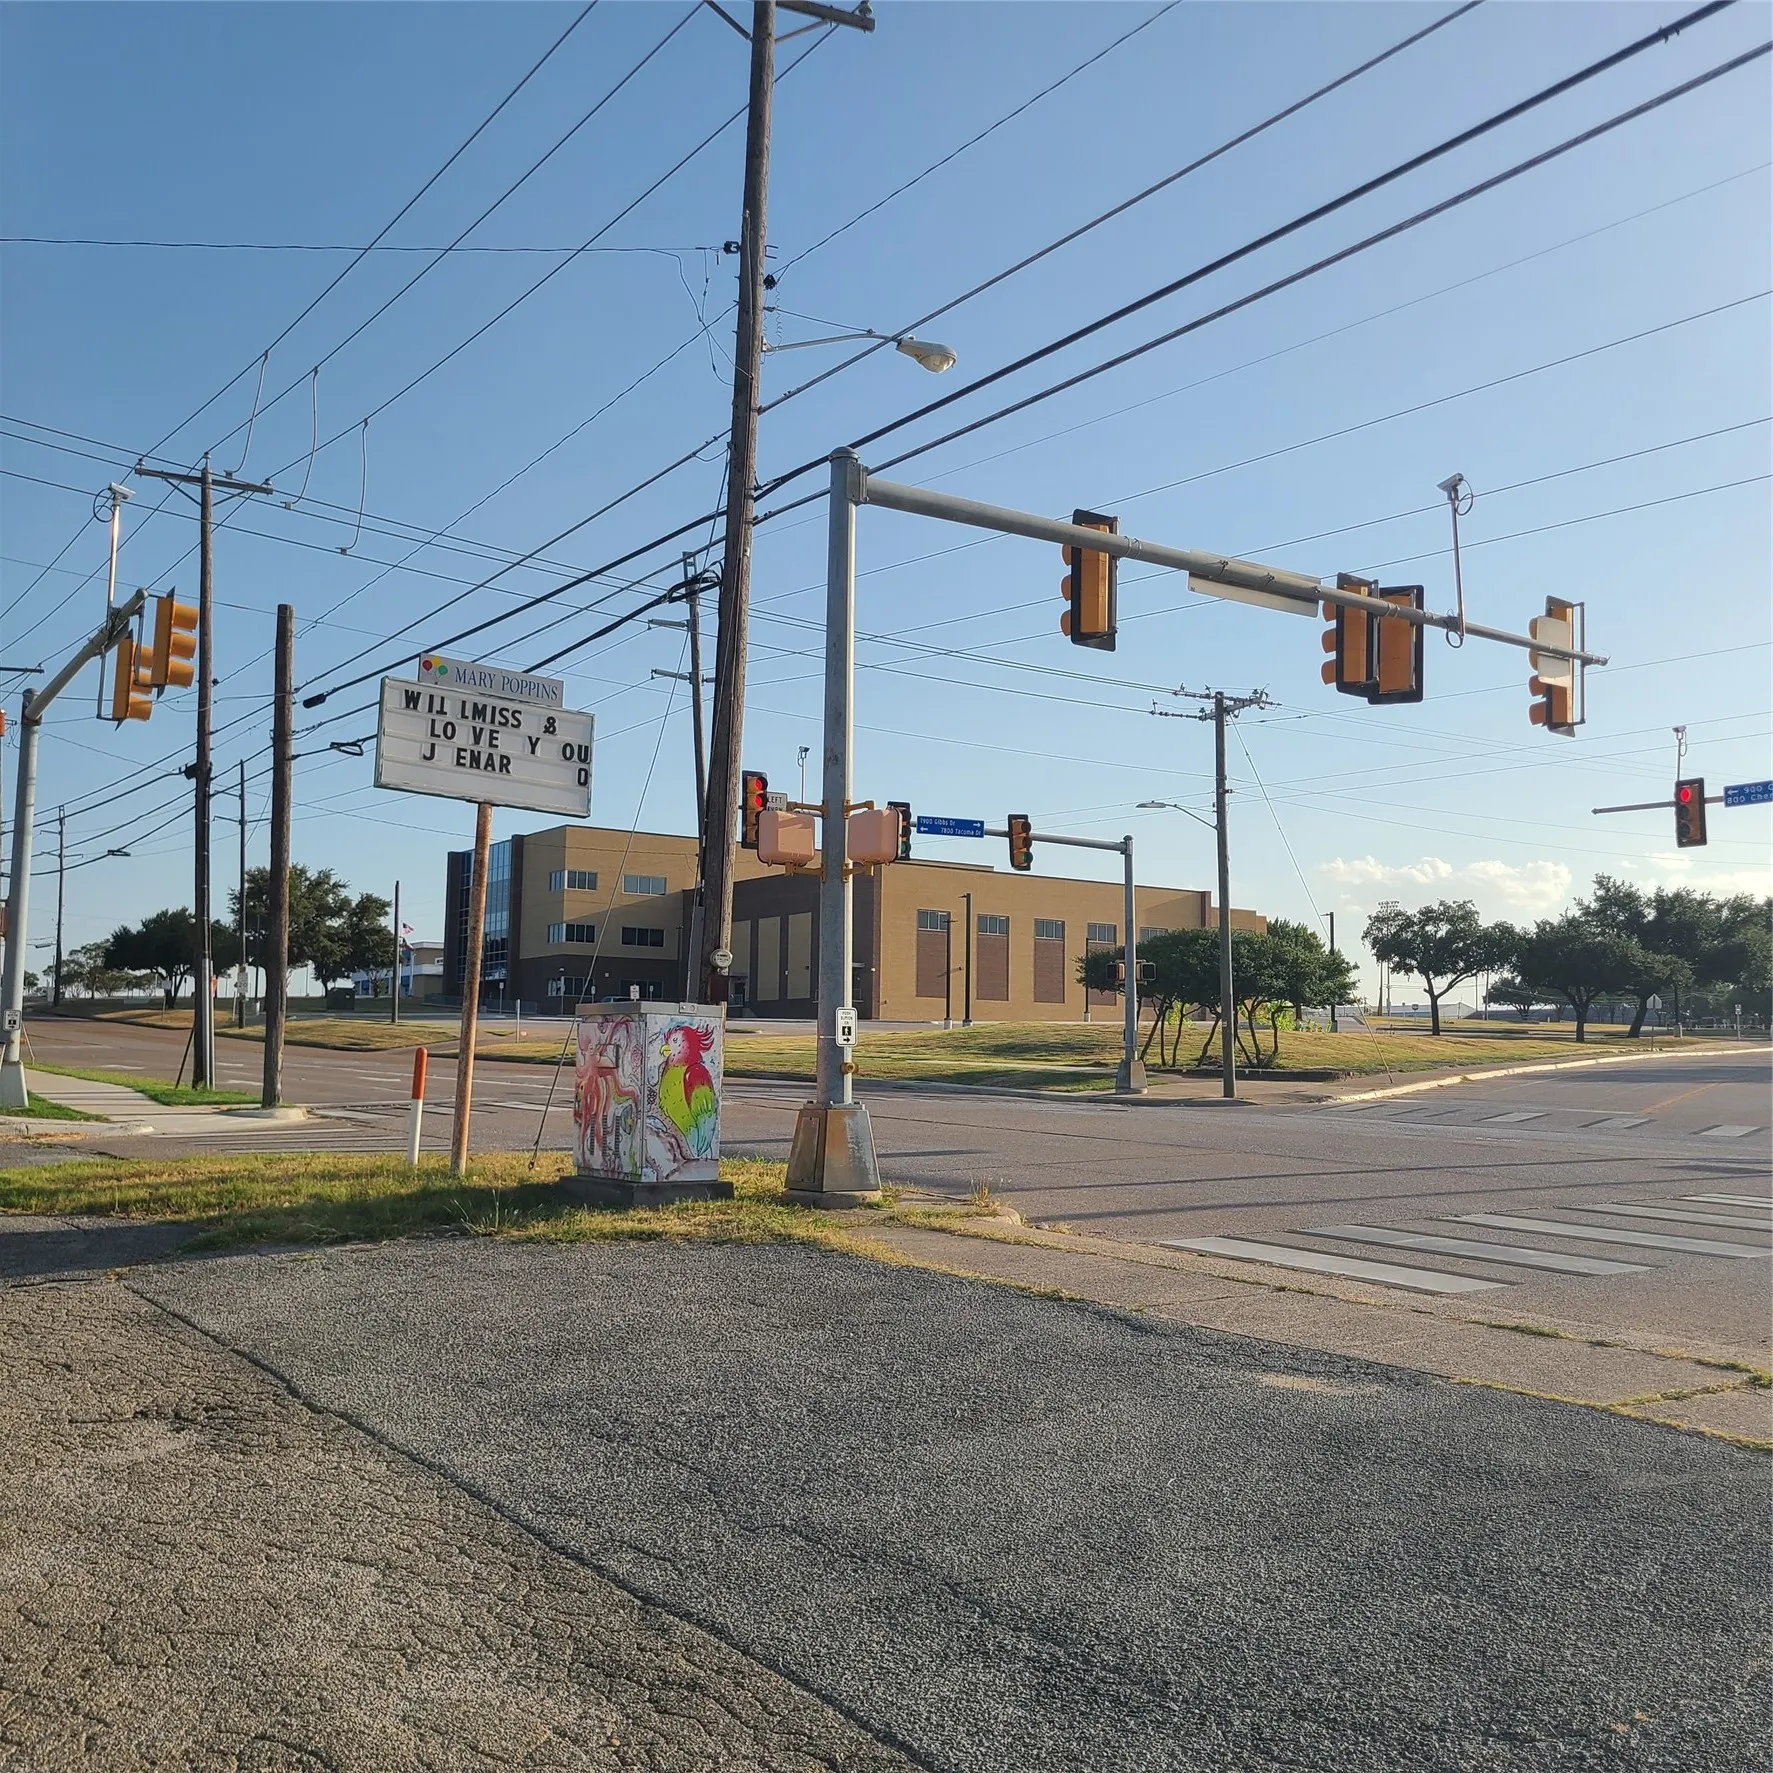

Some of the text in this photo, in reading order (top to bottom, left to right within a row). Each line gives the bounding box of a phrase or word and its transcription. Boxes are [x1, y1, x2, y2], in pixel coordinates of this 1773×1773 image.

[455, 666, 558, 700] MARY POPPINS
[543, 716, 558, 736] &
[1727, 796, 1745, 804] 800
[955, 828, 974, 836] Tacoma
